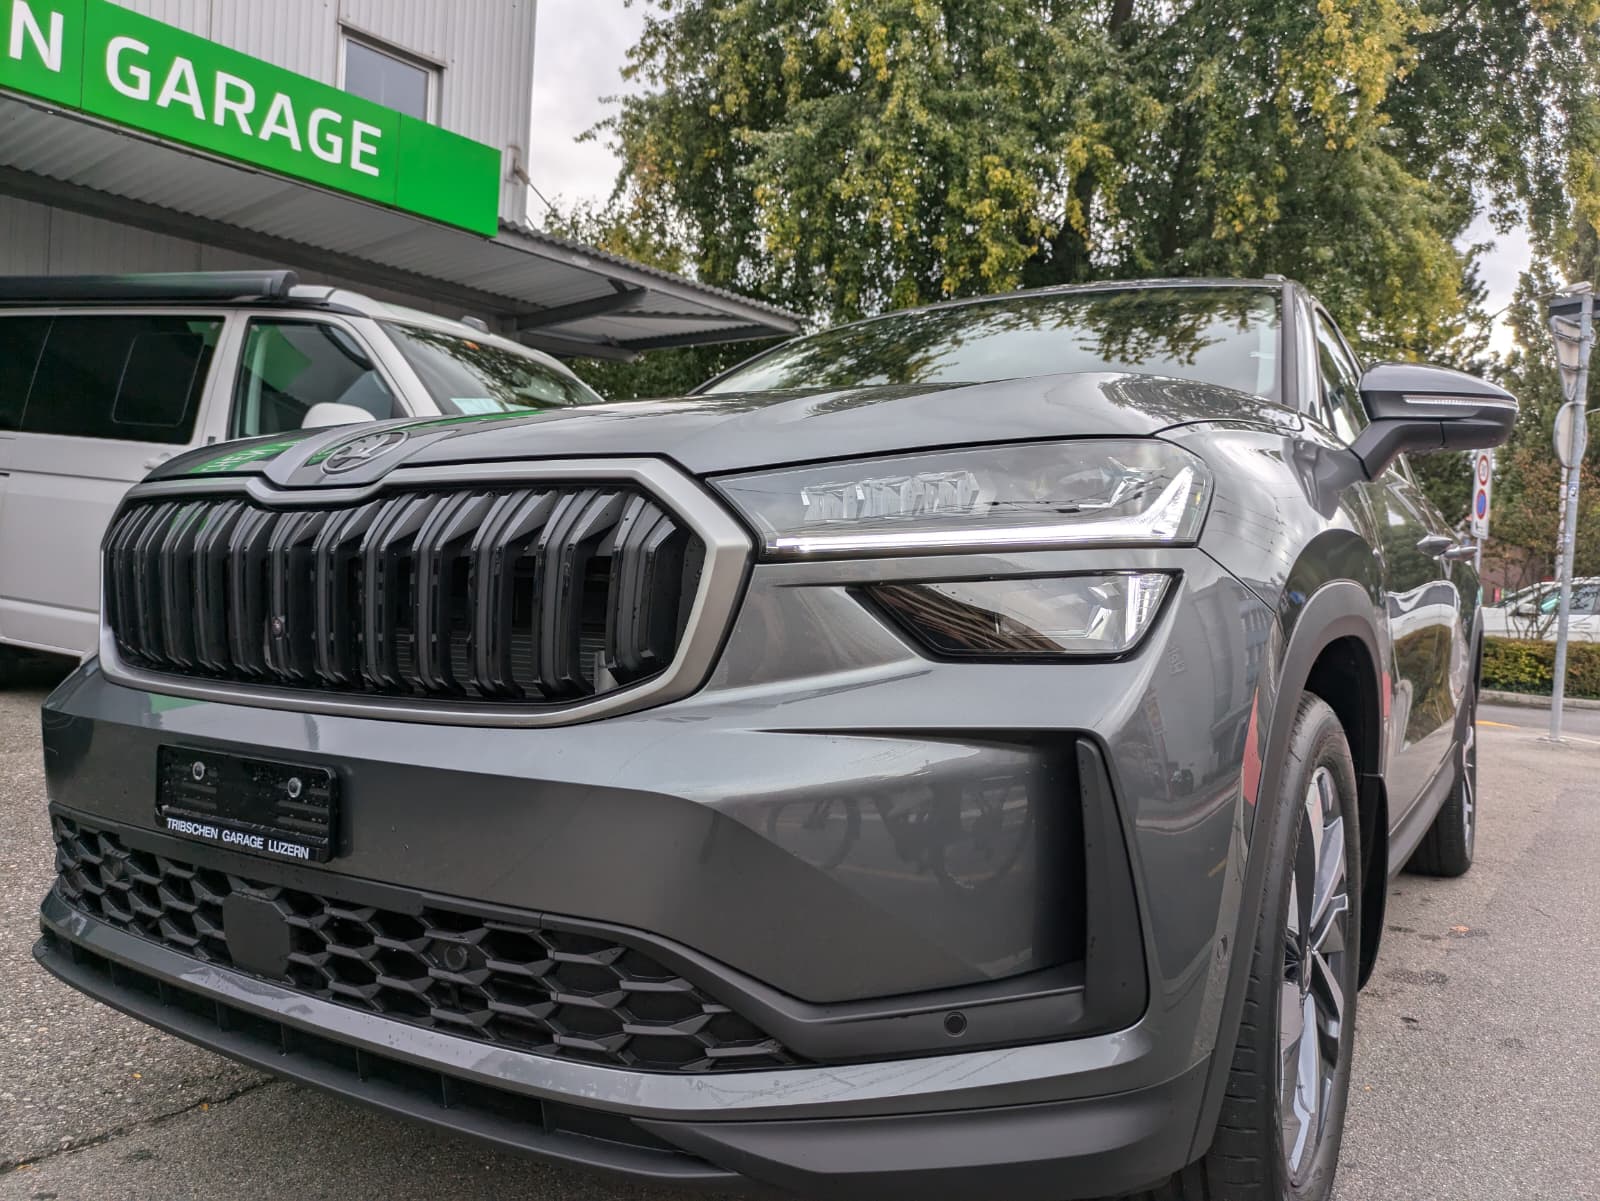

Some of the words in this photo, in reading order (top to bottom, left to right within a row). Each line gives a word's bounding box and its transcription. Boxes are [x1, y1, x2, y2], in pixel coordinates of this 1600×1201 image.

[9, 0, 64, 72] N
[105, 36, 382, 177] GARAGE
[166, 817, 218, 839] TRIBSCHEN
[222, 830, 264, 849] GARAGE
[268, 839, 309, 859] LUZERN
